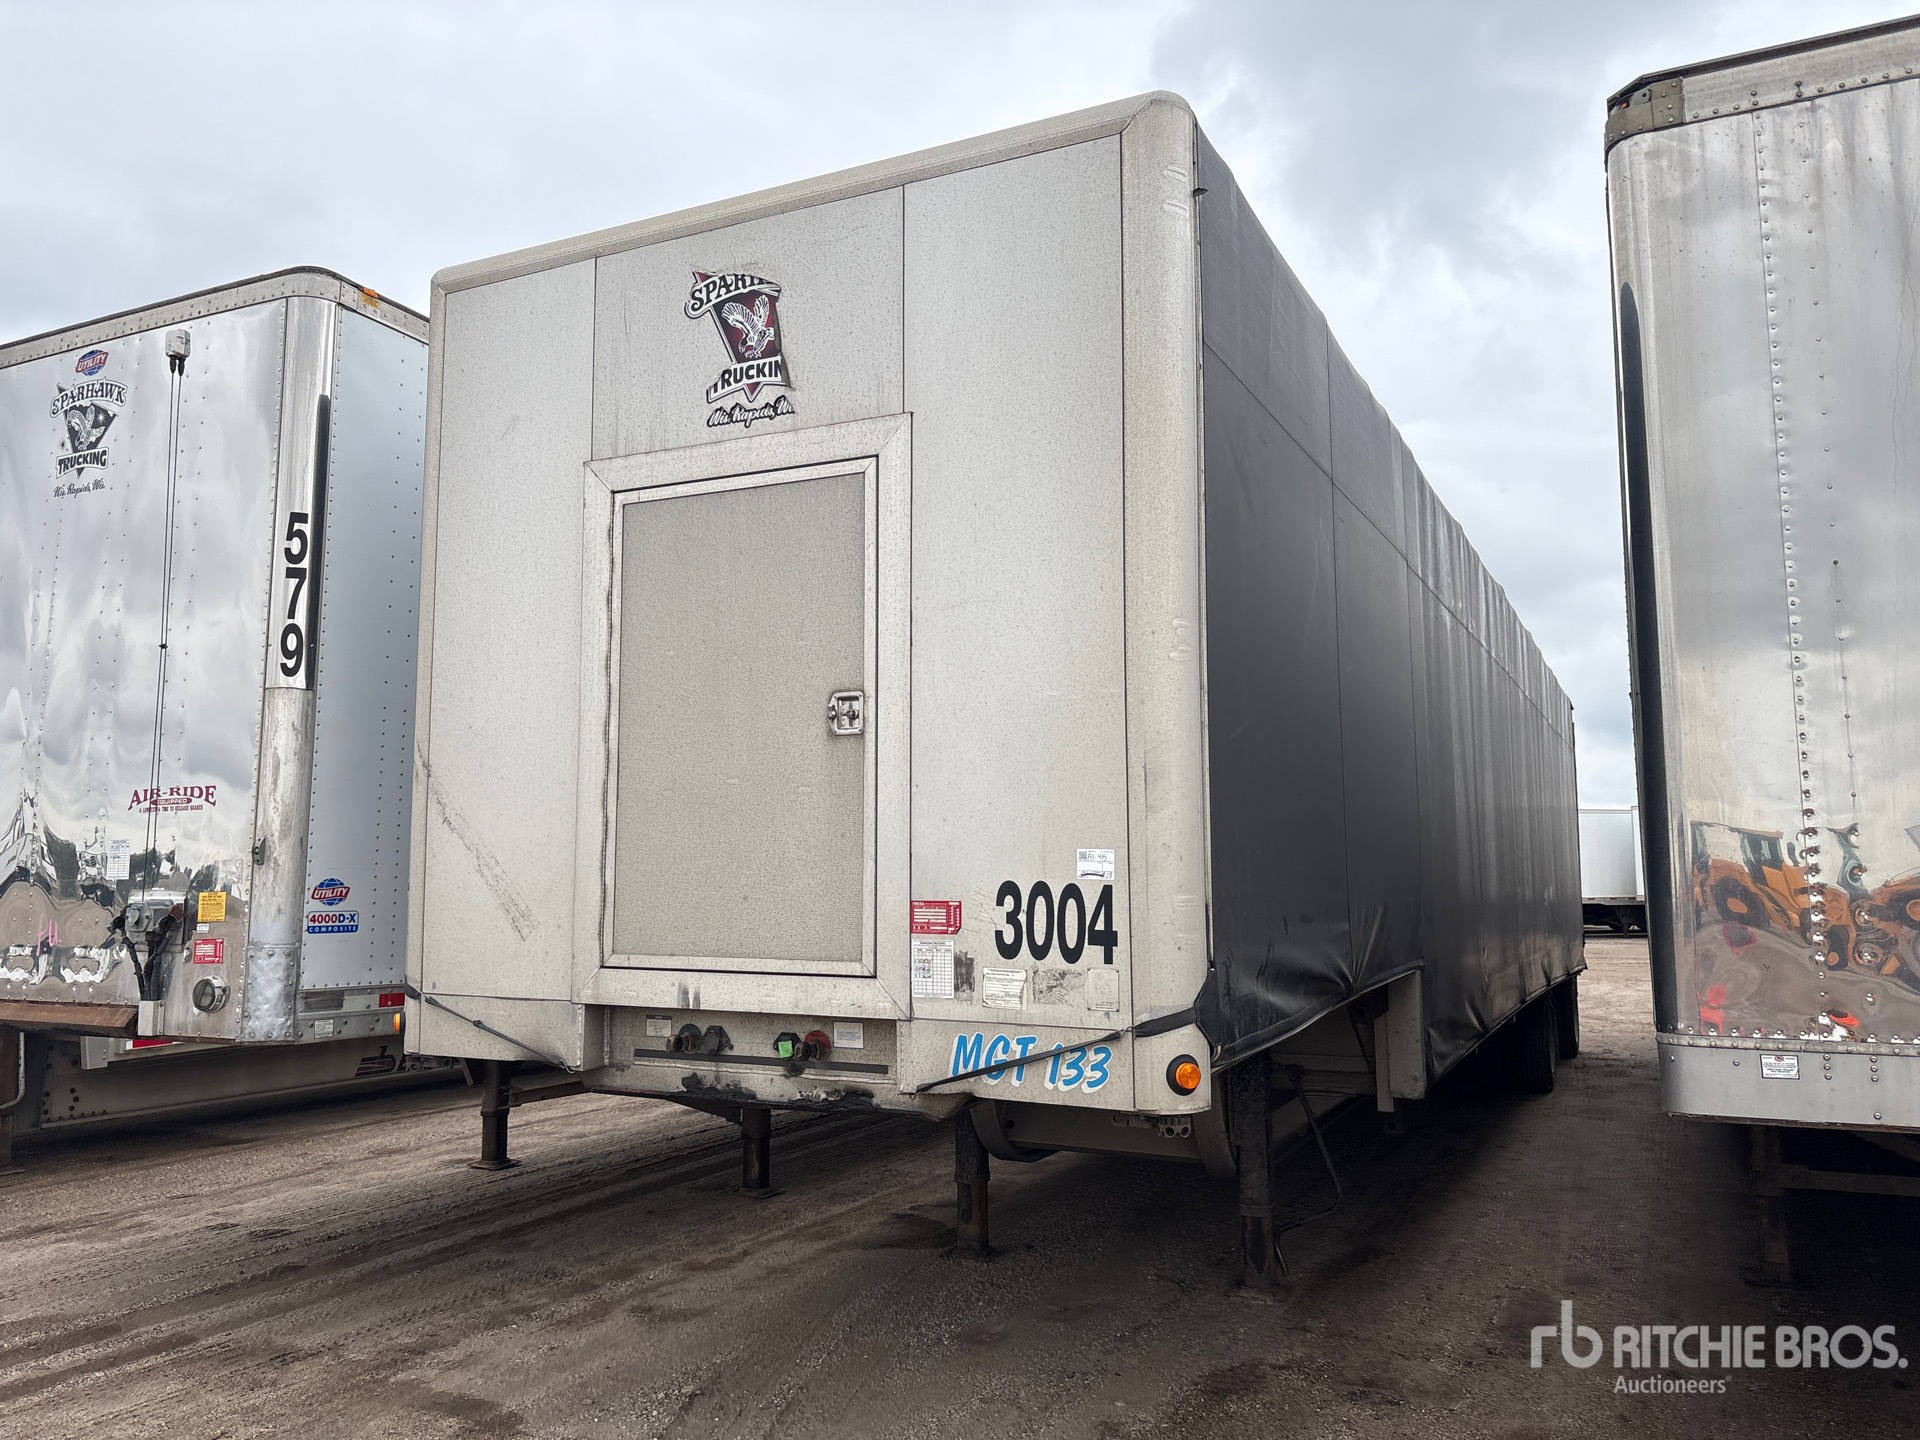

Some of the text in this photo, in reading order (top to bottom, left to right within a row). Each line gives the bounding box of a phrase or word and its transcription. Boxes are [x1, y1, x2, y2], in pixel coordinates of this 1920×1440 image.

[78, 353, 106, 372] UTILITY
[51, 382, 126, 416] SPARHAWK
[57, 449, 107, 475] TRUCKING
[280, 512, 310, 678] 579
[128, 785, 217, 811] AIR-RIDE
[314, 887, 349, 899] UTILITY
[310, 913, 356, 925] 4000D-X
[995, 879, 1119, 965] 3004
[950, 1032, 1113, 1092] MGT 133
